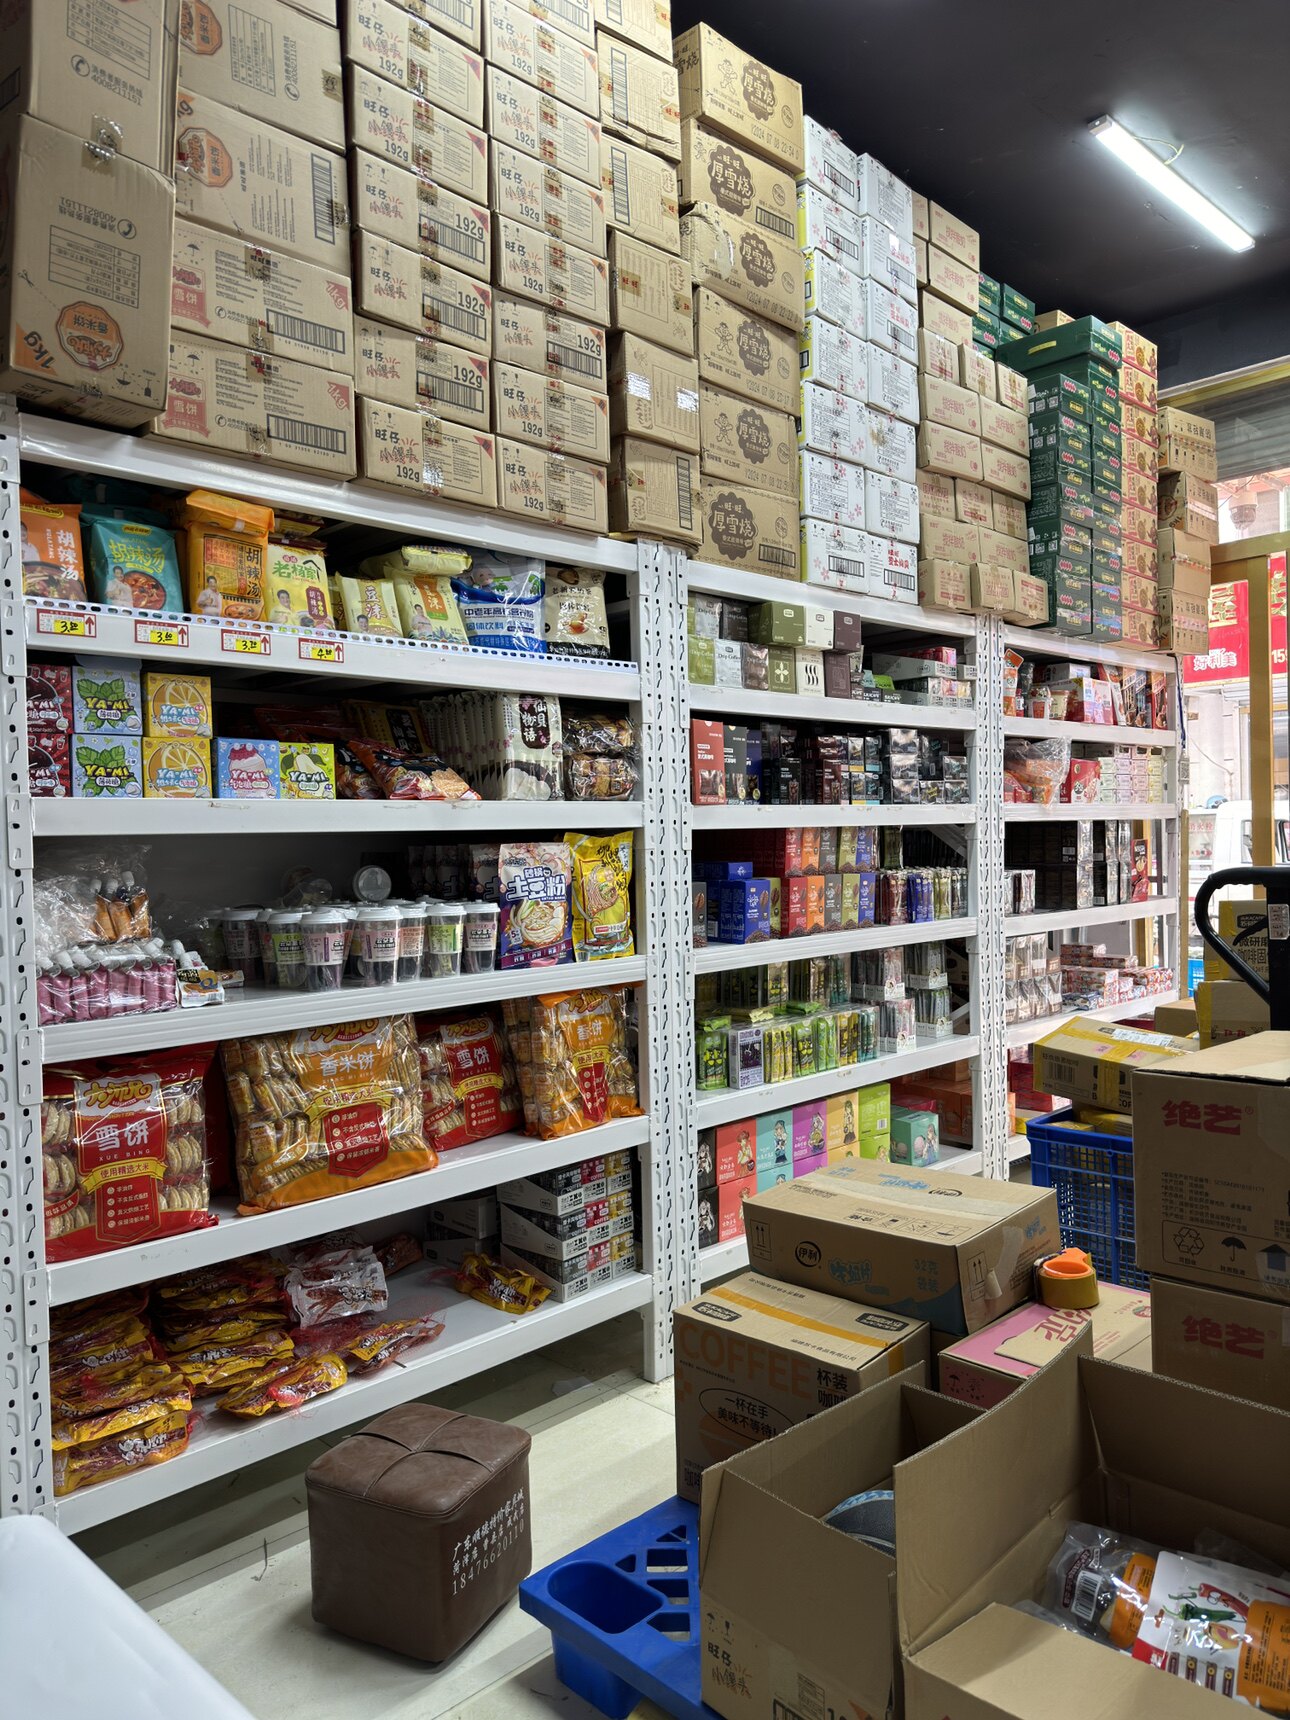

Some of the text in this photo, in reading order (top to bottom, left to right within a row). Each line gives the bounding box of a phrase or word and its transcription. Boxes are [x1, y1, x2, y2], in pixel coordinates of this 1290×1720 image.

[358, 14, 384, 35] 旺仔
[493, 17, 514, 35] 旺仔
[379, 57, 403, 80] 192g
[511, 55, 532, 76] 192g
[744, 73, 774, 105] 厚雪烧
[364, 99, 389, 118] 旺仔
[496, 92, 519, 110] 旺仔
[514, 129, 535, 149] 192g
[384, 140, 409, 162] 192g
[501, 168, 523, 185] 旺仔
[711, 160, 752, 196] 厚雪烧
[366, 185, 387, 200] 旺仔
[519, 203, 540, 222] 192g
[455, 213, 484, 239] 192g
[504, 242, 526, 256] 旺仔
[742, 244, 773, 272] 厚雪烧
[370, 266, 391, 281] 旺仔
[523, 276, 543, 293] 192g
[326, 284, 346, 310] 1kg
[458, 291, 486, 316] 192g
[501, 319, 519, 331] 旺仔
[362, 348, 384, 362] 旺仔
[577, 335, 602, 355] 192g
[739, 334, 770, 360] 厚雪烧
[454, 366, 483, 388] 192g
[327, 384, 347, 410] 1kg
[503, 387, 525, 401] 旺仔
[374, 429, 399, 444] 旺仔
[521, 421, 543, 437] 192g
[739, 426, 769, 446] 厚雪烧
[396, 465, 420, 483] 192g
[506, 463, 527, 476] 旺仔
[523, 496, 544, 511] 192g
[713, 510, 753, 537] 厚雪烧
[56, 530, 79, 581] 胡辣汤
[109, 538, 165, 574] 胡辣汤
[246, 547, 261, 598] 胡辣汤
[1193, 648, 1238, 671] 好利美
[86, 697, 130, 710] YA-MI
[160, 705, 195, 716] YA-MI
[535, 700, 547, 728] 仙贝
[521, 711, 537, 742] 物语
[85, 765, 130, 777] YA-MI
[157, 768, 195, 780] YA-MI
[231, 770, 264, 781] YA-MI
[289, 771, 328, 782] YA-MI
[506, 875, 566, 900] 土豆粉
[320, 1050, 375, 1077] 香米饼
[457, 1046, 490, 1069] 雪饼
[1161, 1099, 1243, 1136] 绝艺
[96, 1120, 149, 1151] 雪饼
[100, 1163, 150, 1178] 使用精选大米
[798, 1245, 819, 1262] 伊利
[1182, 1315, 1265, 1361] 绝艺
[679, 1322, 813, 1400] COFFEE
[817, 1367, 849, 1393] 杯装
[725, 1396, 769, 1420] 一杯在手
[452, 1522, 525, 1596] 18476620110
[707, 1641, 732, 1667] 旺仔
[711, 1665, 752, 1699] 小馒头
